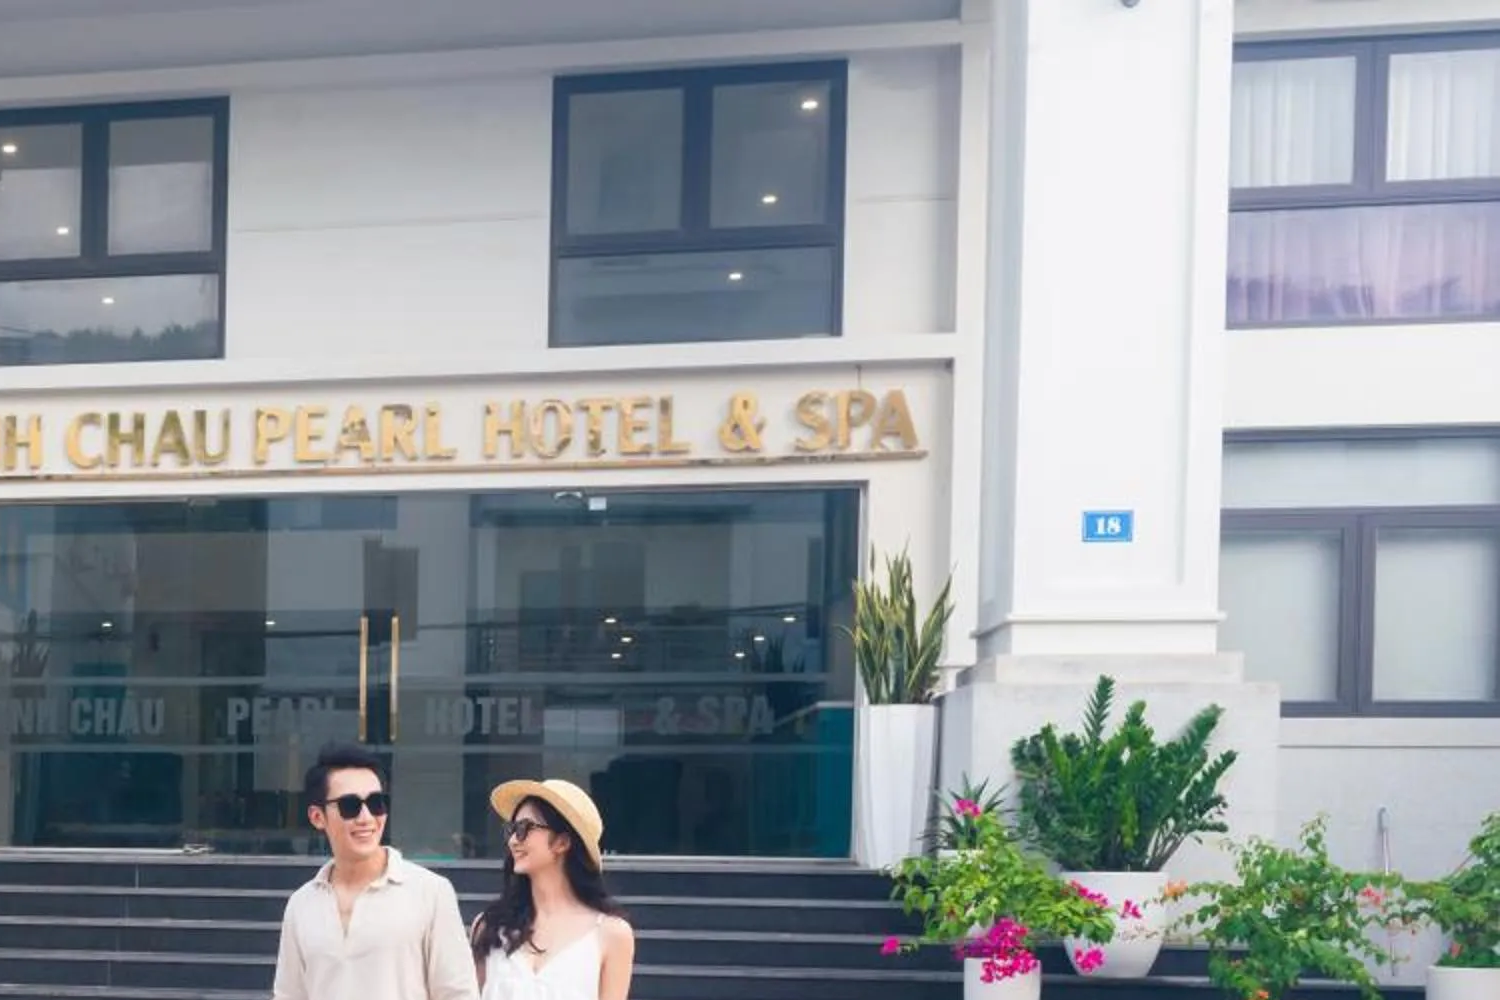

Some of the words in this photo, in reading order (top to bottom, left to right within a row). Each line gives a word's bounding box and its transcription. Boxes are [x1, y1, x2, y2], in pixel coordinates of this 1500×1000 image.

[66, 407, 231, 468] CHAU
[253, 402, 457, 464] PEARL
[482, 393, 691, 459] HOTEL
[717, 390, 765, 453] &
[794, 388, 920, 451] SPA
[1096, 516, 1122, 535] 18
[70, 696, 165, 735] CHAU
